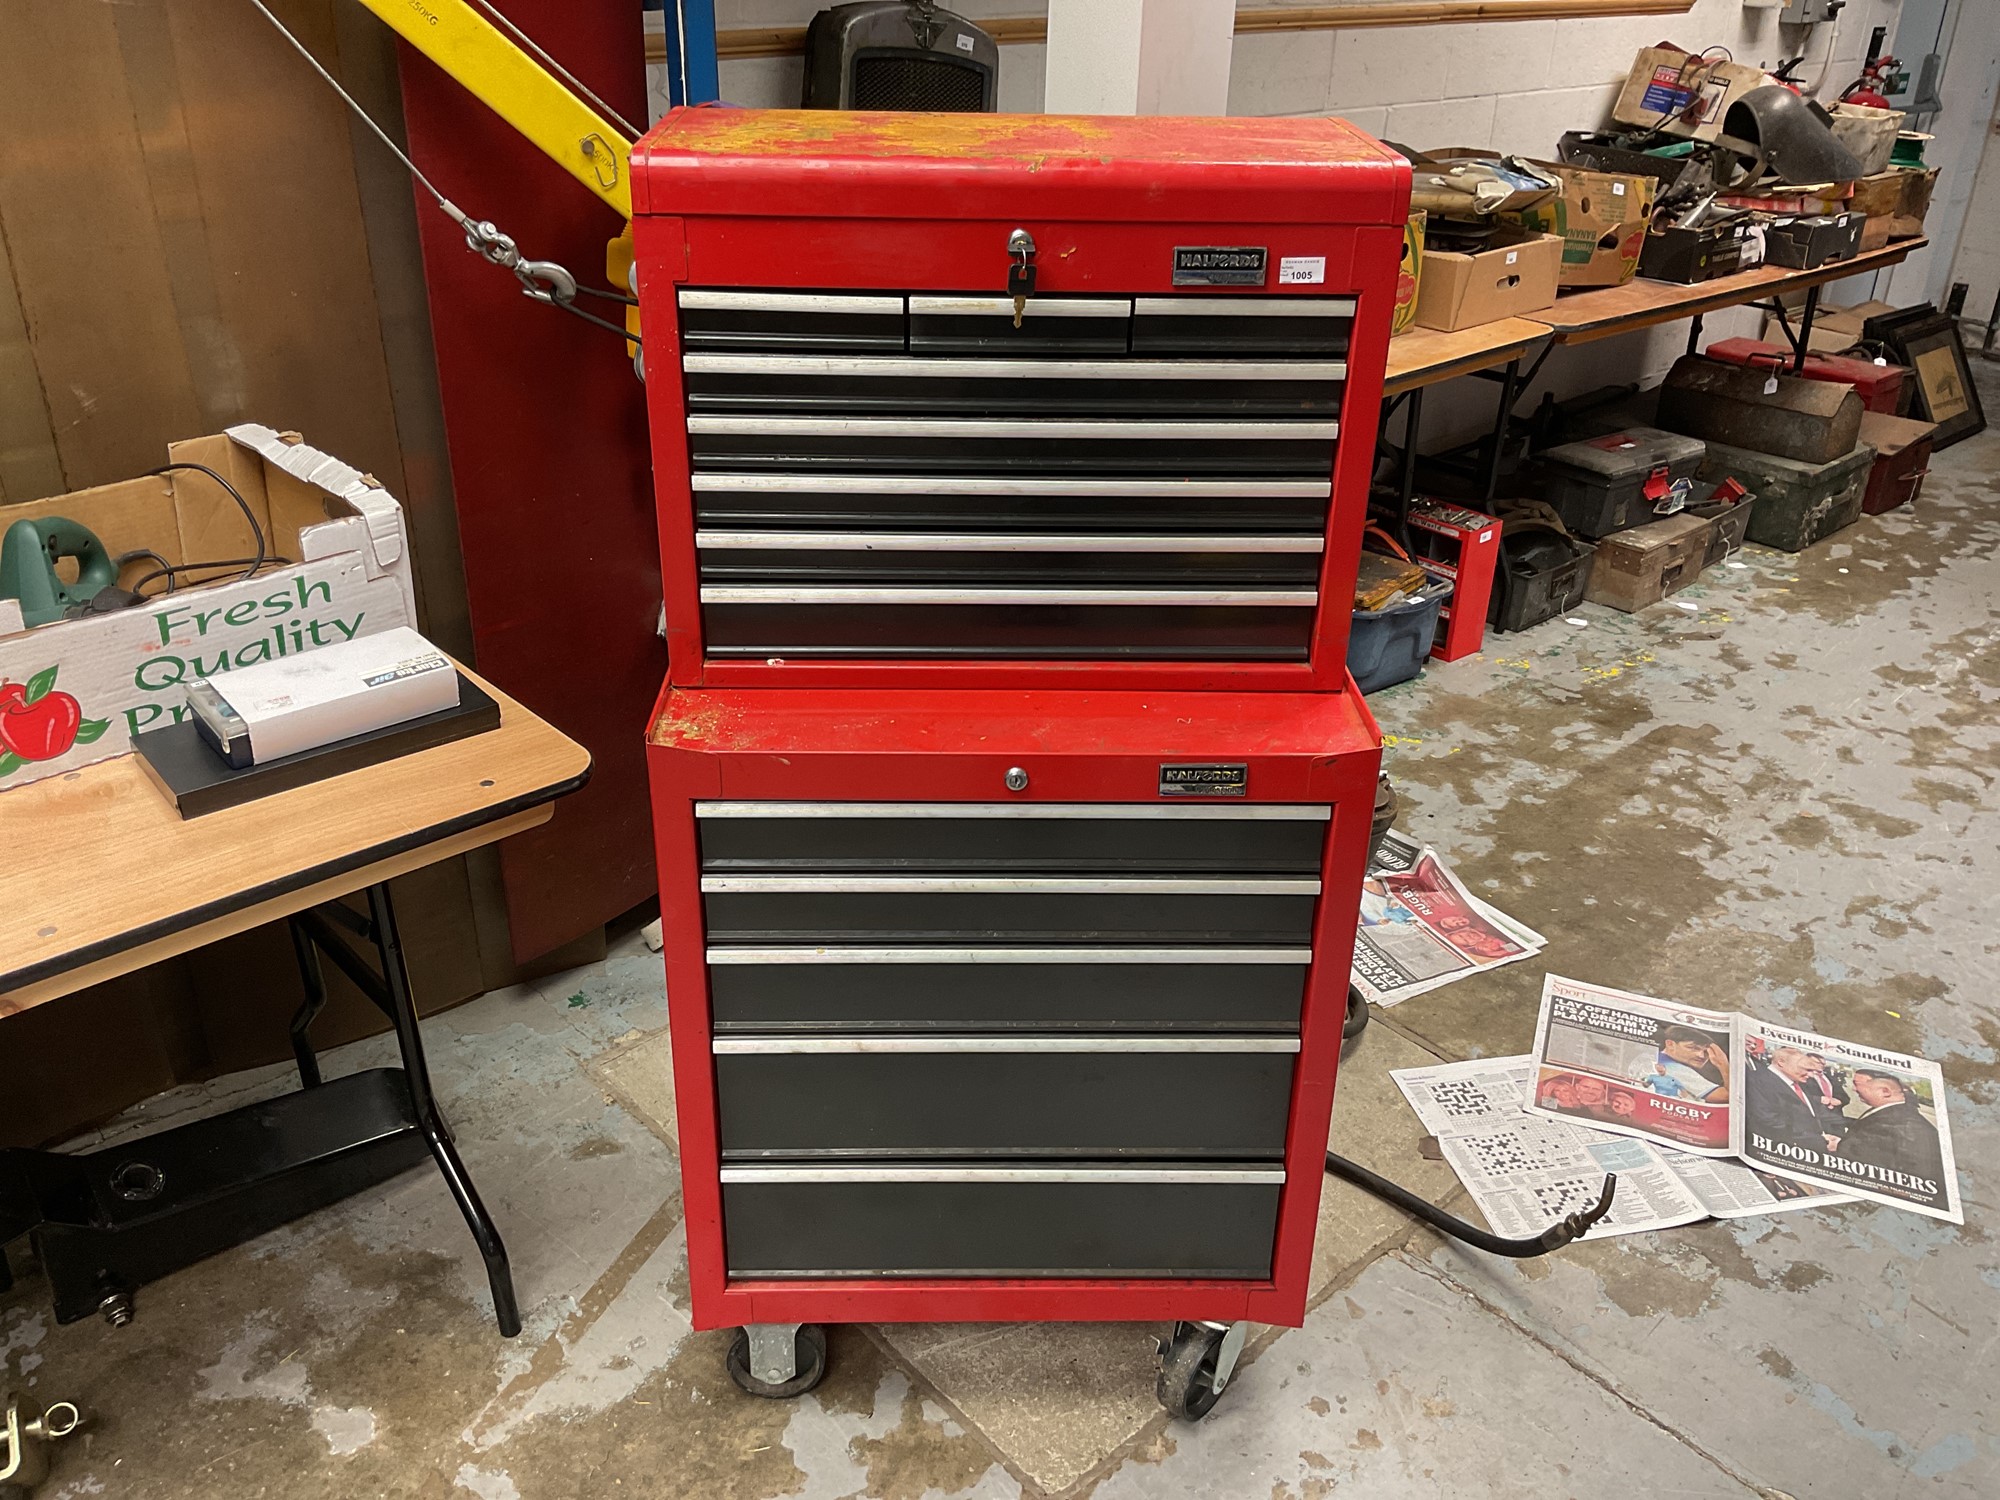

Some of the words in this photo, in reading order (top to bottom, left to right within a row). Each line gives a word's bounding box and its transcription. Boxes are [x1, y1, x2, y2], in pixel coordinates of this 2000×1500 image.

[1180, 253, 1260, 268] HALFORDS
[1291, 271, 1313, 280] 1005
[152, 575, 332, 647] Fresh
[134, 612, 366, 691] Quality
[395, 659, 444, 677] Clarke
[1166, 770, 1241, 781] HALFORDS
[1552, 983, 1587, 999] Sport
[1553, 1010, 1586, 1022] PLAY
[1588, 1018, 1622, 1031] WITH
[1578, 1009, 1588, 1018] A
[1590, 1012, 1637, 1028] DREAM
[1639, 1023, 1658, 1033] TO
[1584, 1005, 1610, 1015] OFF
[1611, 1010, 1659, 1027] HARRY,
[1760, 1026, 1823, 1050] Evening
[1835, 1044, 1912, 1070] Standard
[1649, 1098, 1712, 1120] RUGBY
[1752, 1133, 1819, 1163] BLOOD
[1822, 1153, 1938, 1195] BROTHERS
